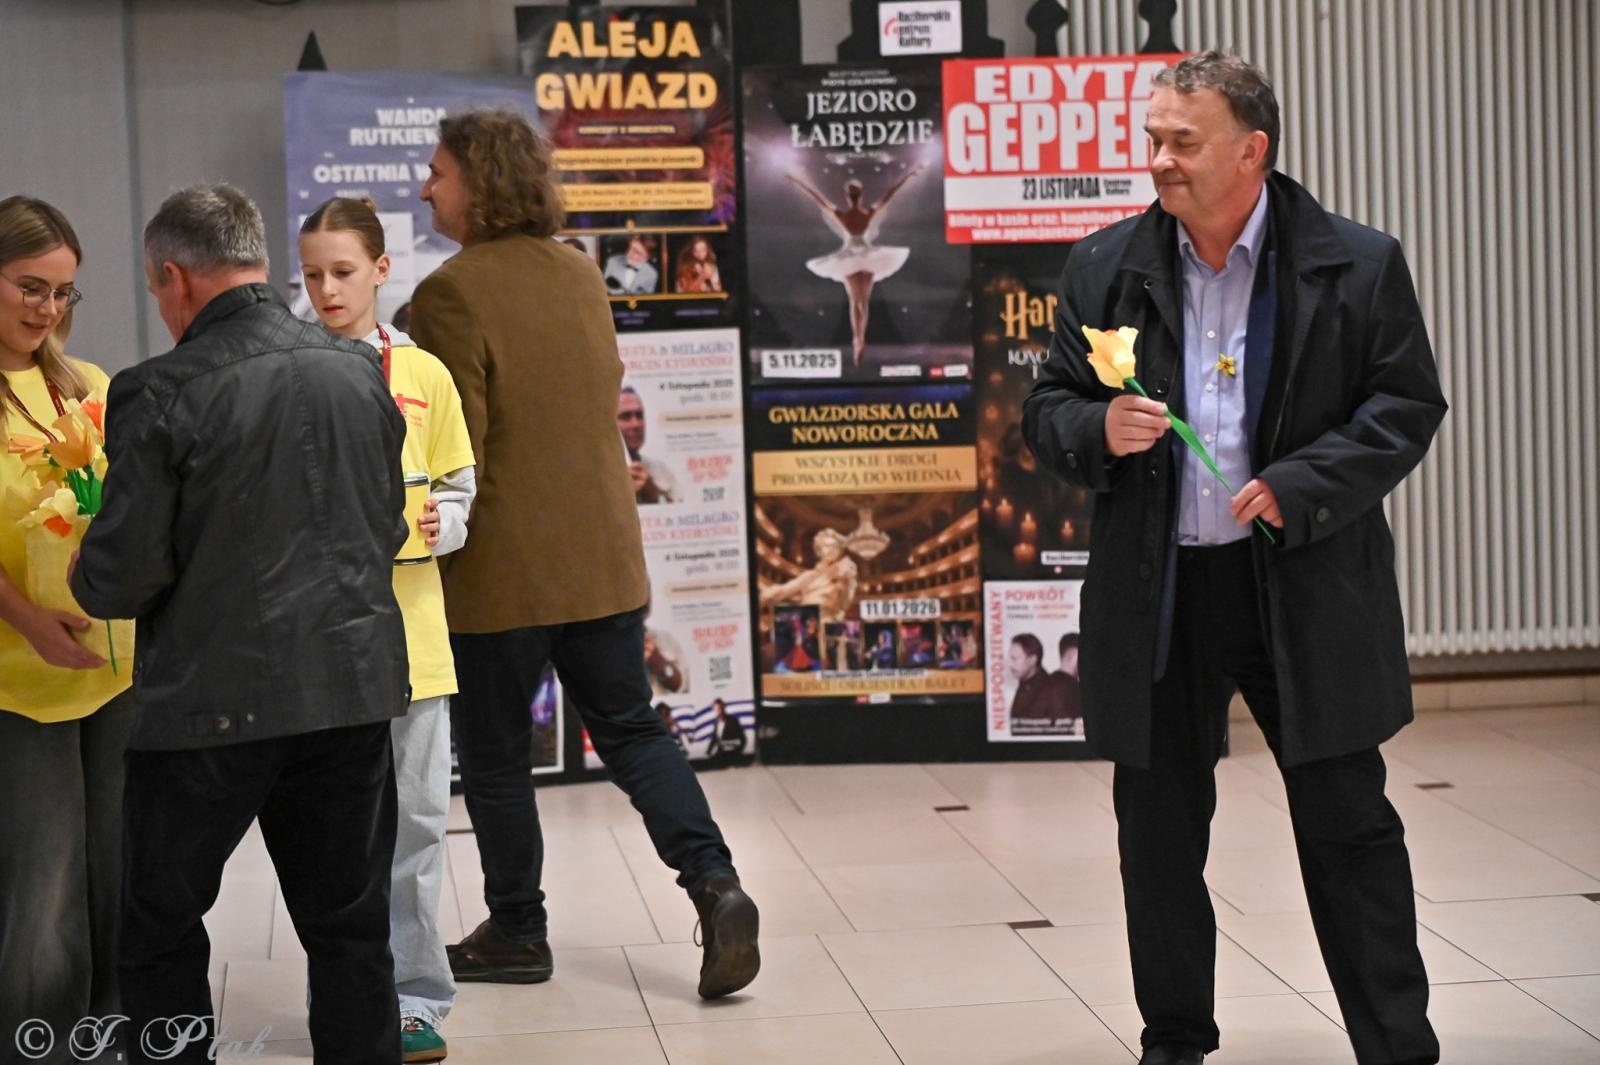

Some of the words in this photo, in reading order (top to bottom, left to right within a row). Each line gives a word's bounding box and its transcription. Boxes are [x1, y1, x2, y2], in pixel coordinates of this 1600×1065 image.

[547, 20, 702, 59] ALEJA
[535, 71, 719, 111] GWIAZD
[806, 89, 917, 121] JEZIORO
[790, 119, 935, 153] ŁABĘDZIE
[313, 164, 411, 183] OSTATNIA
[1022, 179, 1038, 200] 23
[1040, 177, 1100, 199] LISTOPADA
[768, 354, 837, 369] 5.11.2025
[768, 406, 905, 424] GWIAZDORSKA
[908, 402, 960, 420] GALA
[791, 423, 940, 444] NOWOROCZNA
[795, 455, 883, 470] WSZYSTKIE
[886, 453, 937, 467] DROGI
[772, 473, 860, 487] PROWADZĄ
[863, 472, 887, 484] DO
[890, 469, 962, 484] WIEDNIA
[1004, 586, 1065, 601] POWRÓT
[865, 601, 938, 616] 11.01.2026
[989, 590, 1006, 731] NIESPODZIEWANY
